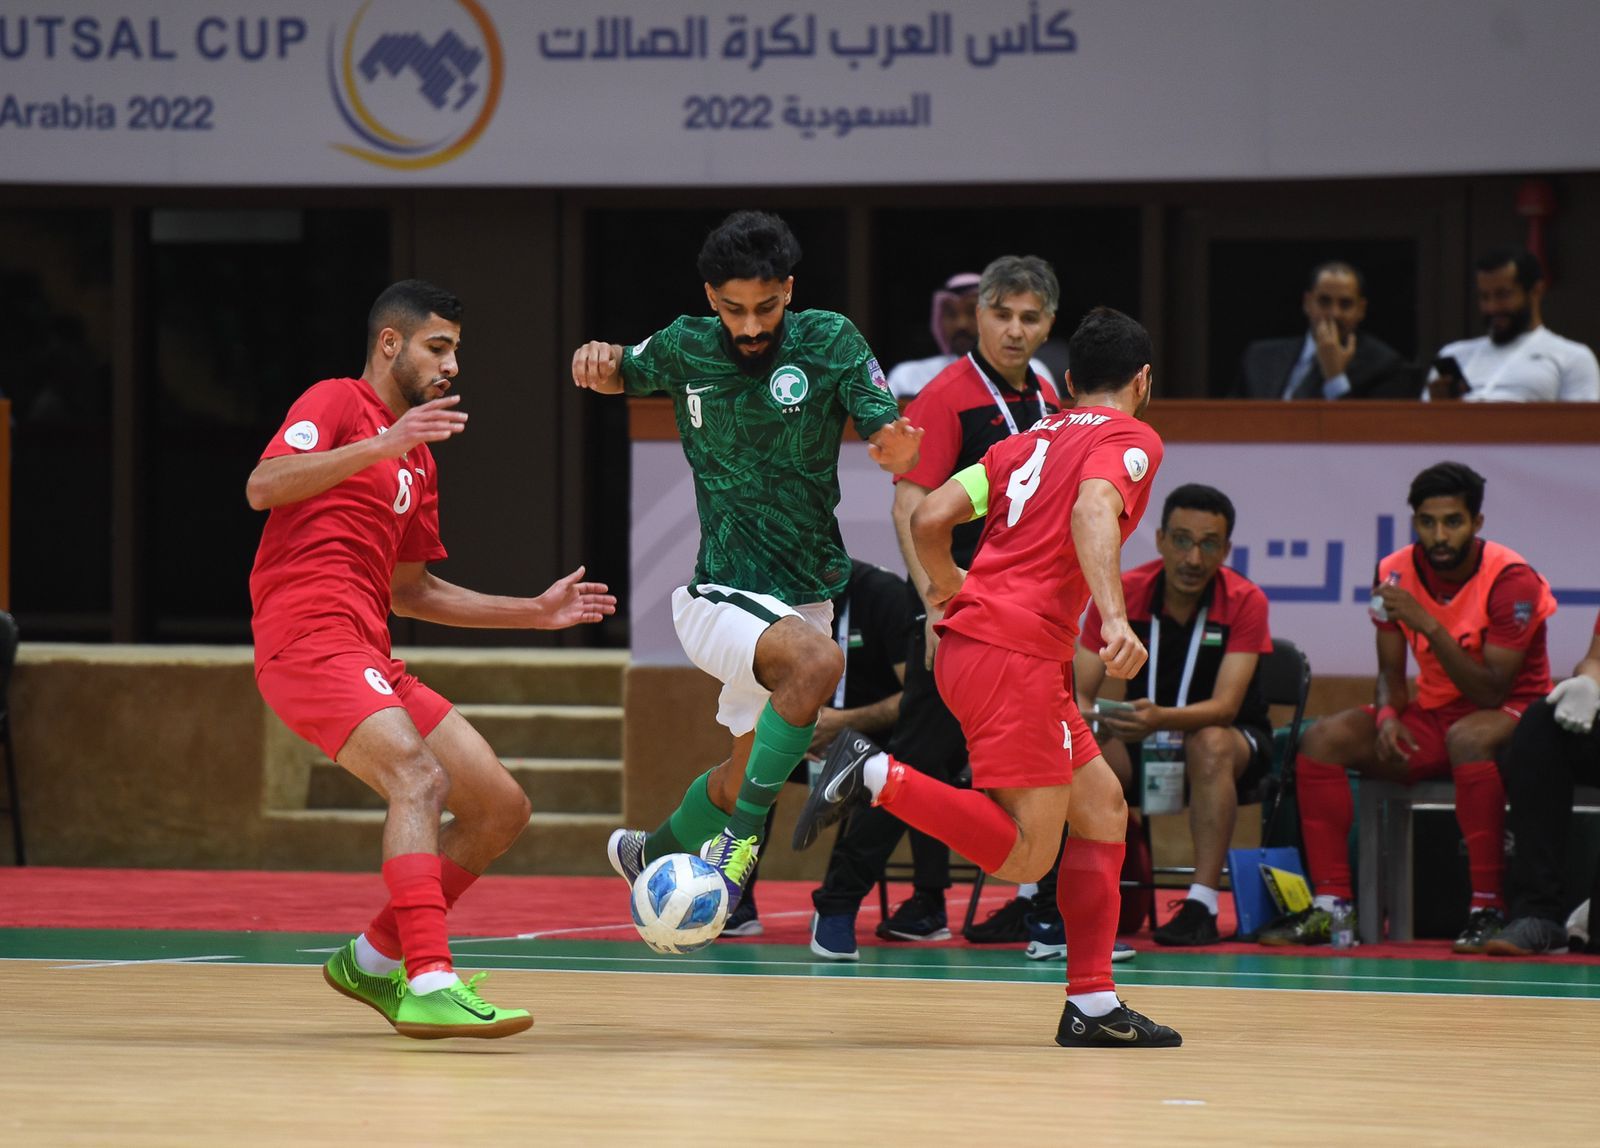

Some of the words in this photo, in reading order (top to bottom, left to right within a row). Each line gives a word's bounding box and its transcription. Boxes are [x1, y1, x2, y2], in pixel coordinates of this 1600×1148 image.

[0, 15, 176, 61] UTSAL
[195, 16, 308, 61] CUP
[538, 16, 708, 60] الصالات
[721, 13, 816, 70] لكرة
[829, 12, 952, 69] العرب
[966, 0, 1078, 67] كأس
[0, 94, 116, 130] Arabia
[127, 96, 213, 130] 2022
[684, 95, 773, 130] 2022
[782, 93, 931, 138] السعودية
[687, 395, 702, 428] 9
[782, 405, 801, 414] KSA
[393, 468, 413, 515] 6
[1005, 438, 1050, 528] 4
[363, 667, 393, 695] 6
